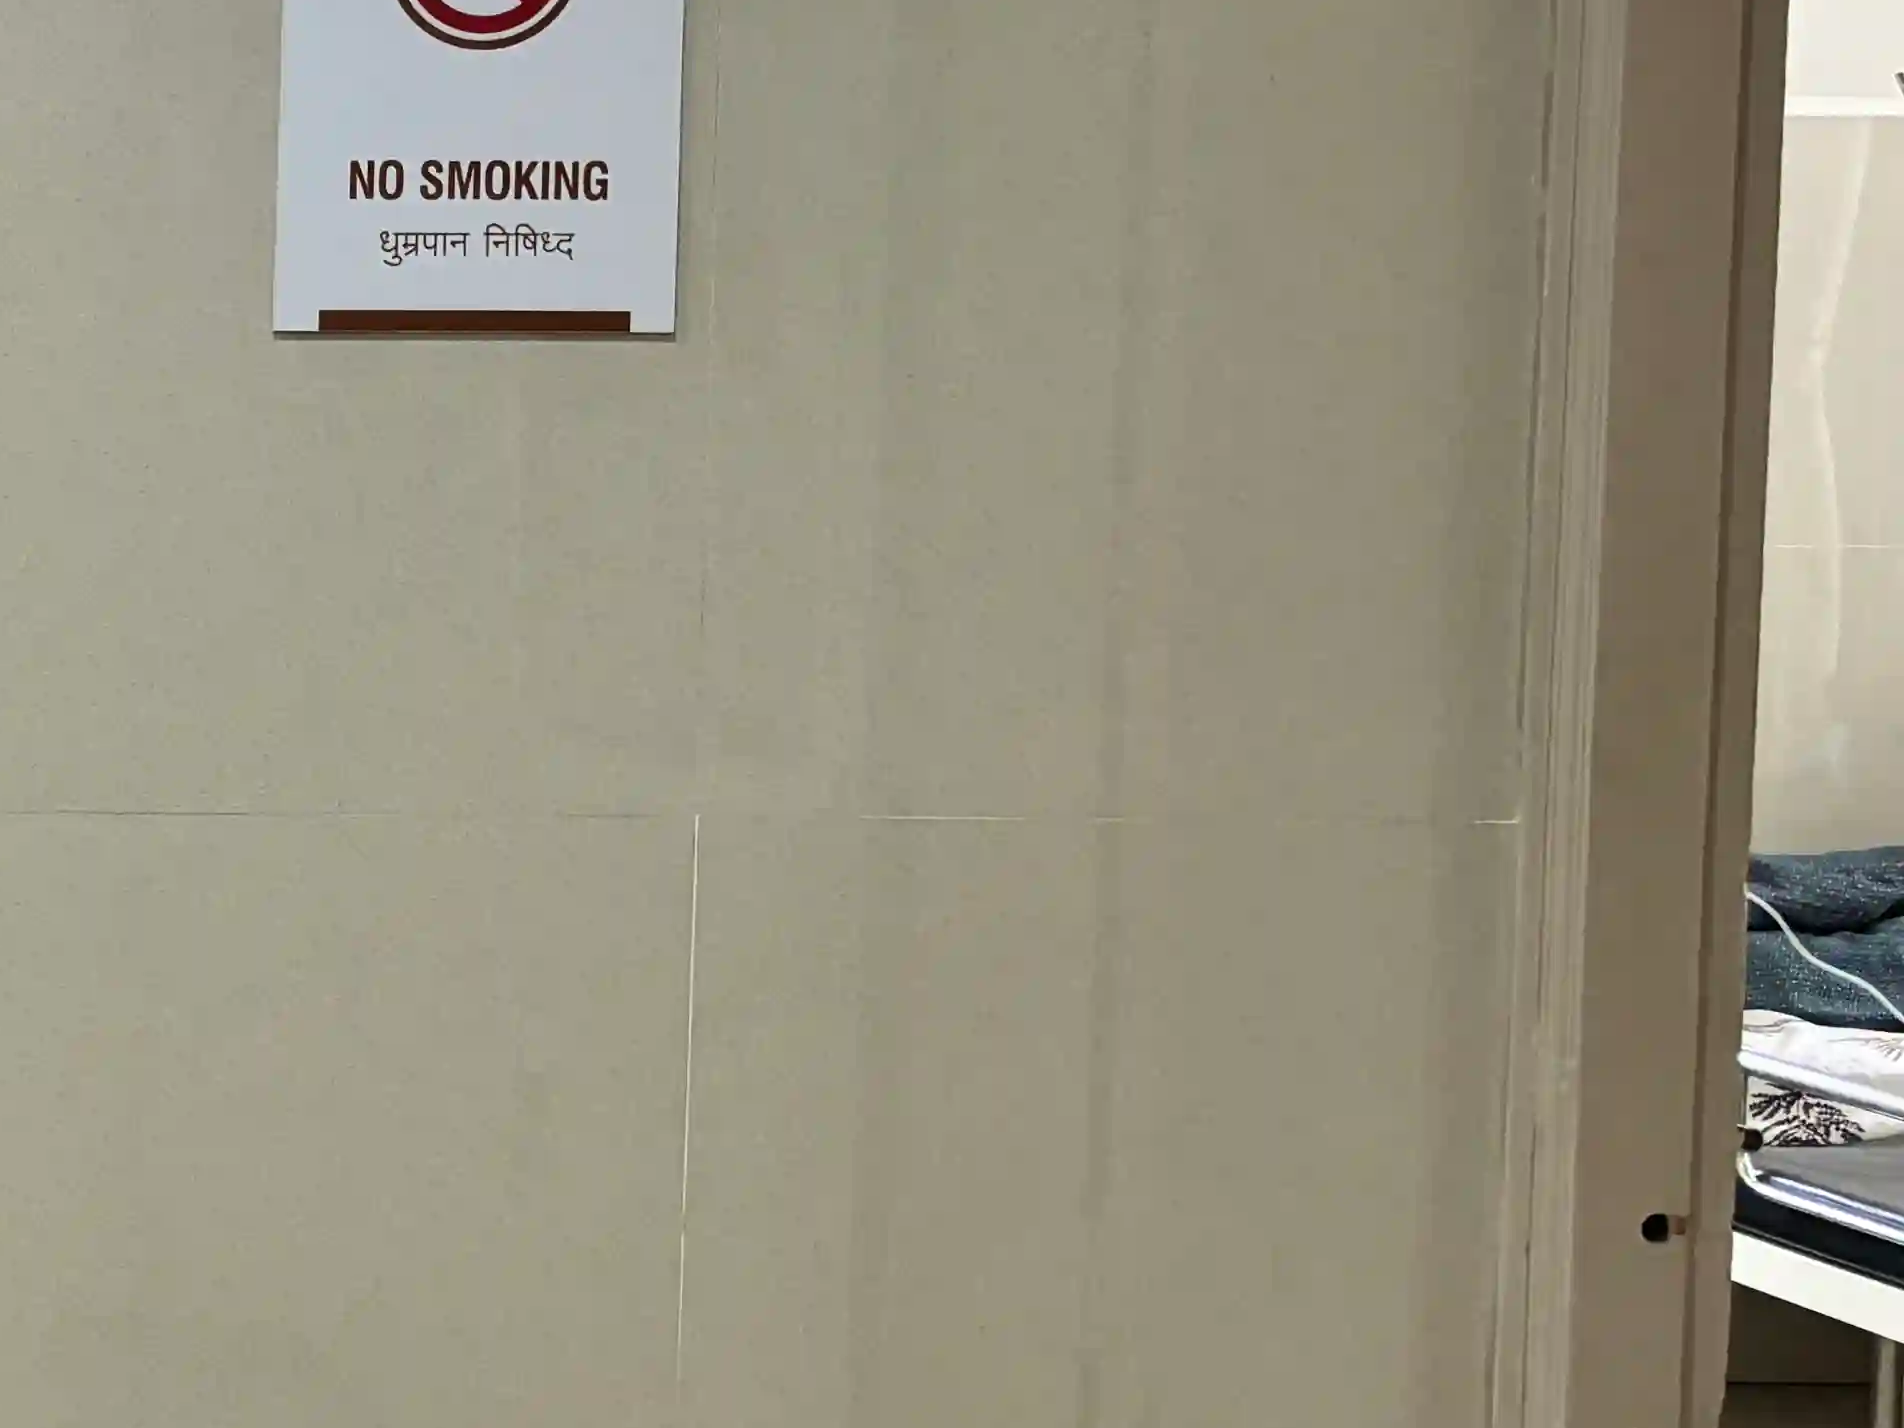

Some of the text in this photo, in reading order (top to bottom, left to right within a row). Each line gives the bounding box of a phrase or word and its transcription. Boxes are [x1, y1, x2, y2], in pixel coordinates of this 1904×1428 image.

[349, 159, 610, 202] NO SMOKING
[379, 229, 471, 267] धुम्रपान
